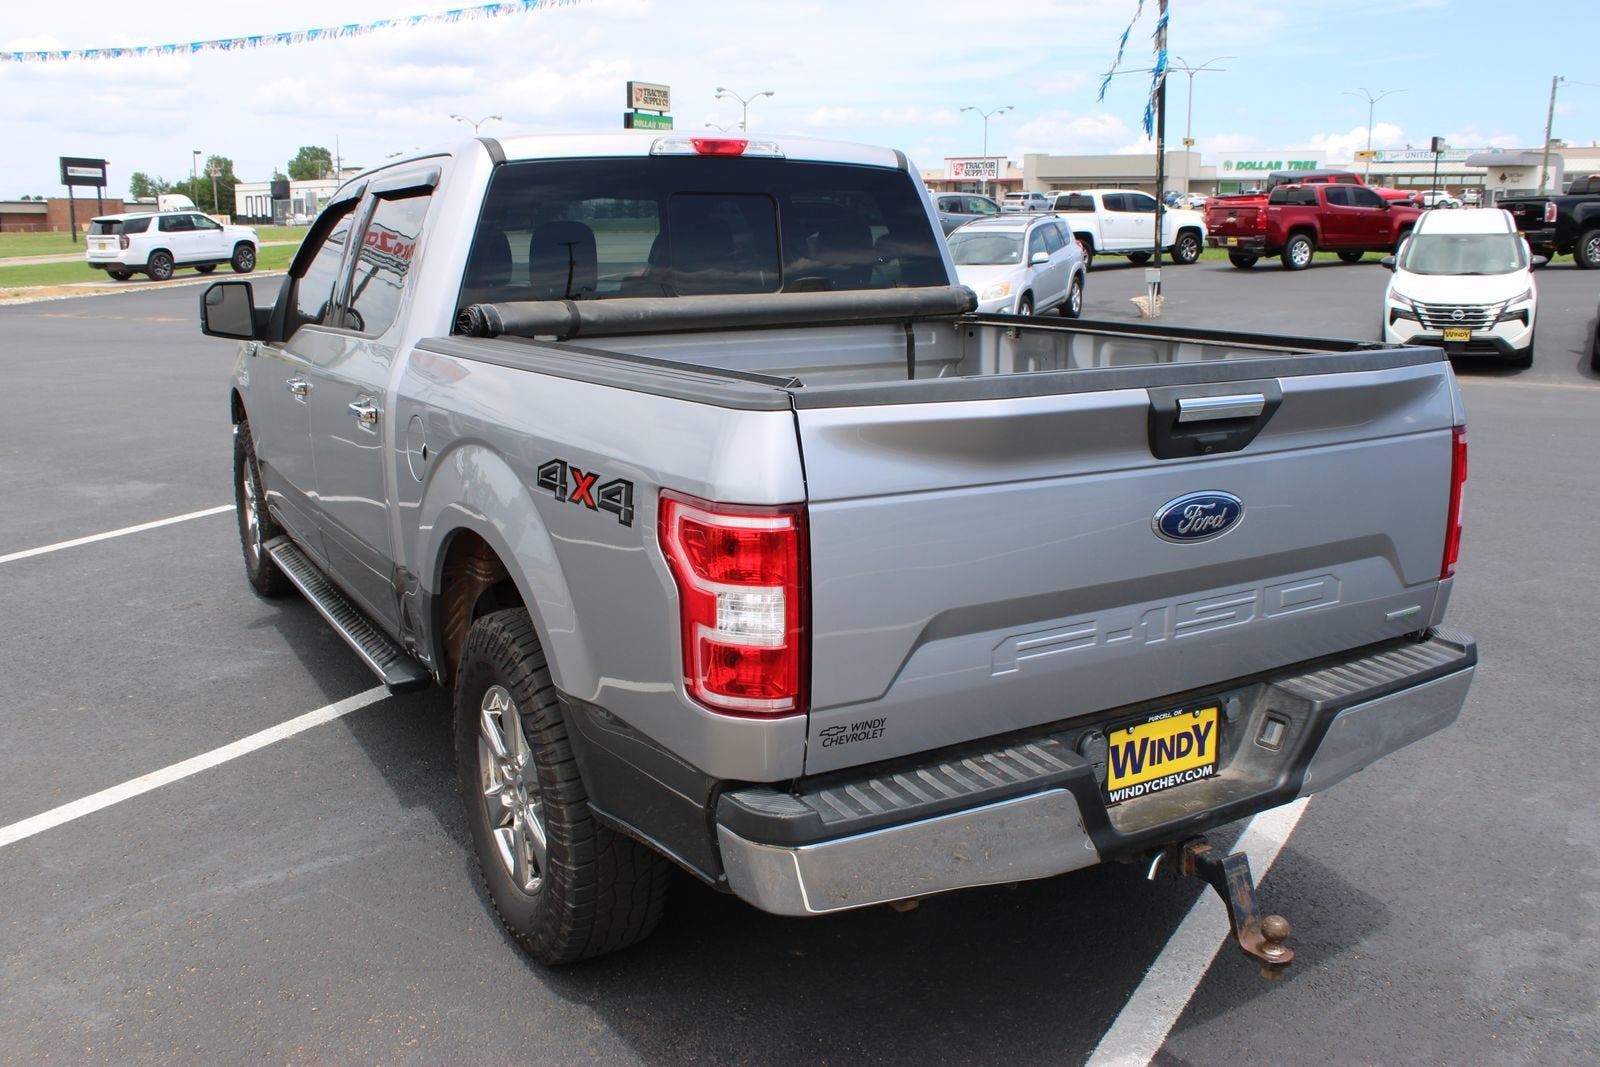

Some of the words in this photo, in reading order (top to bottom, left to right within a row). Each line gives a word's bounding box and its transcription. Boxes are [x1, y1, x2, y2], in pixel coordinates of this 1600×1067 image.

[643, 88, 668, 98] TRACTOR
[643, 96, 663, 106] SUPPLY
[634, 119, 656, 129] DOLLAR
[1404, 151, 1434, 159] UNITED
[965, 161, 996, 169] TRACTOR
[1235, 160, 1283, 170] DOLLAR
[1287, 160, 1318, 170] TREE
[1177, 502, 1228, 534] Ford
[991, 573, 1342, 676] F-150
[1173, 708, 1183, 717] OK
[851, 717, 887, 732] WINDY
[822, 727, 886, 748] CHEVROLET
[1109, 764, 1213, 802] WINDYCHEV.COM
